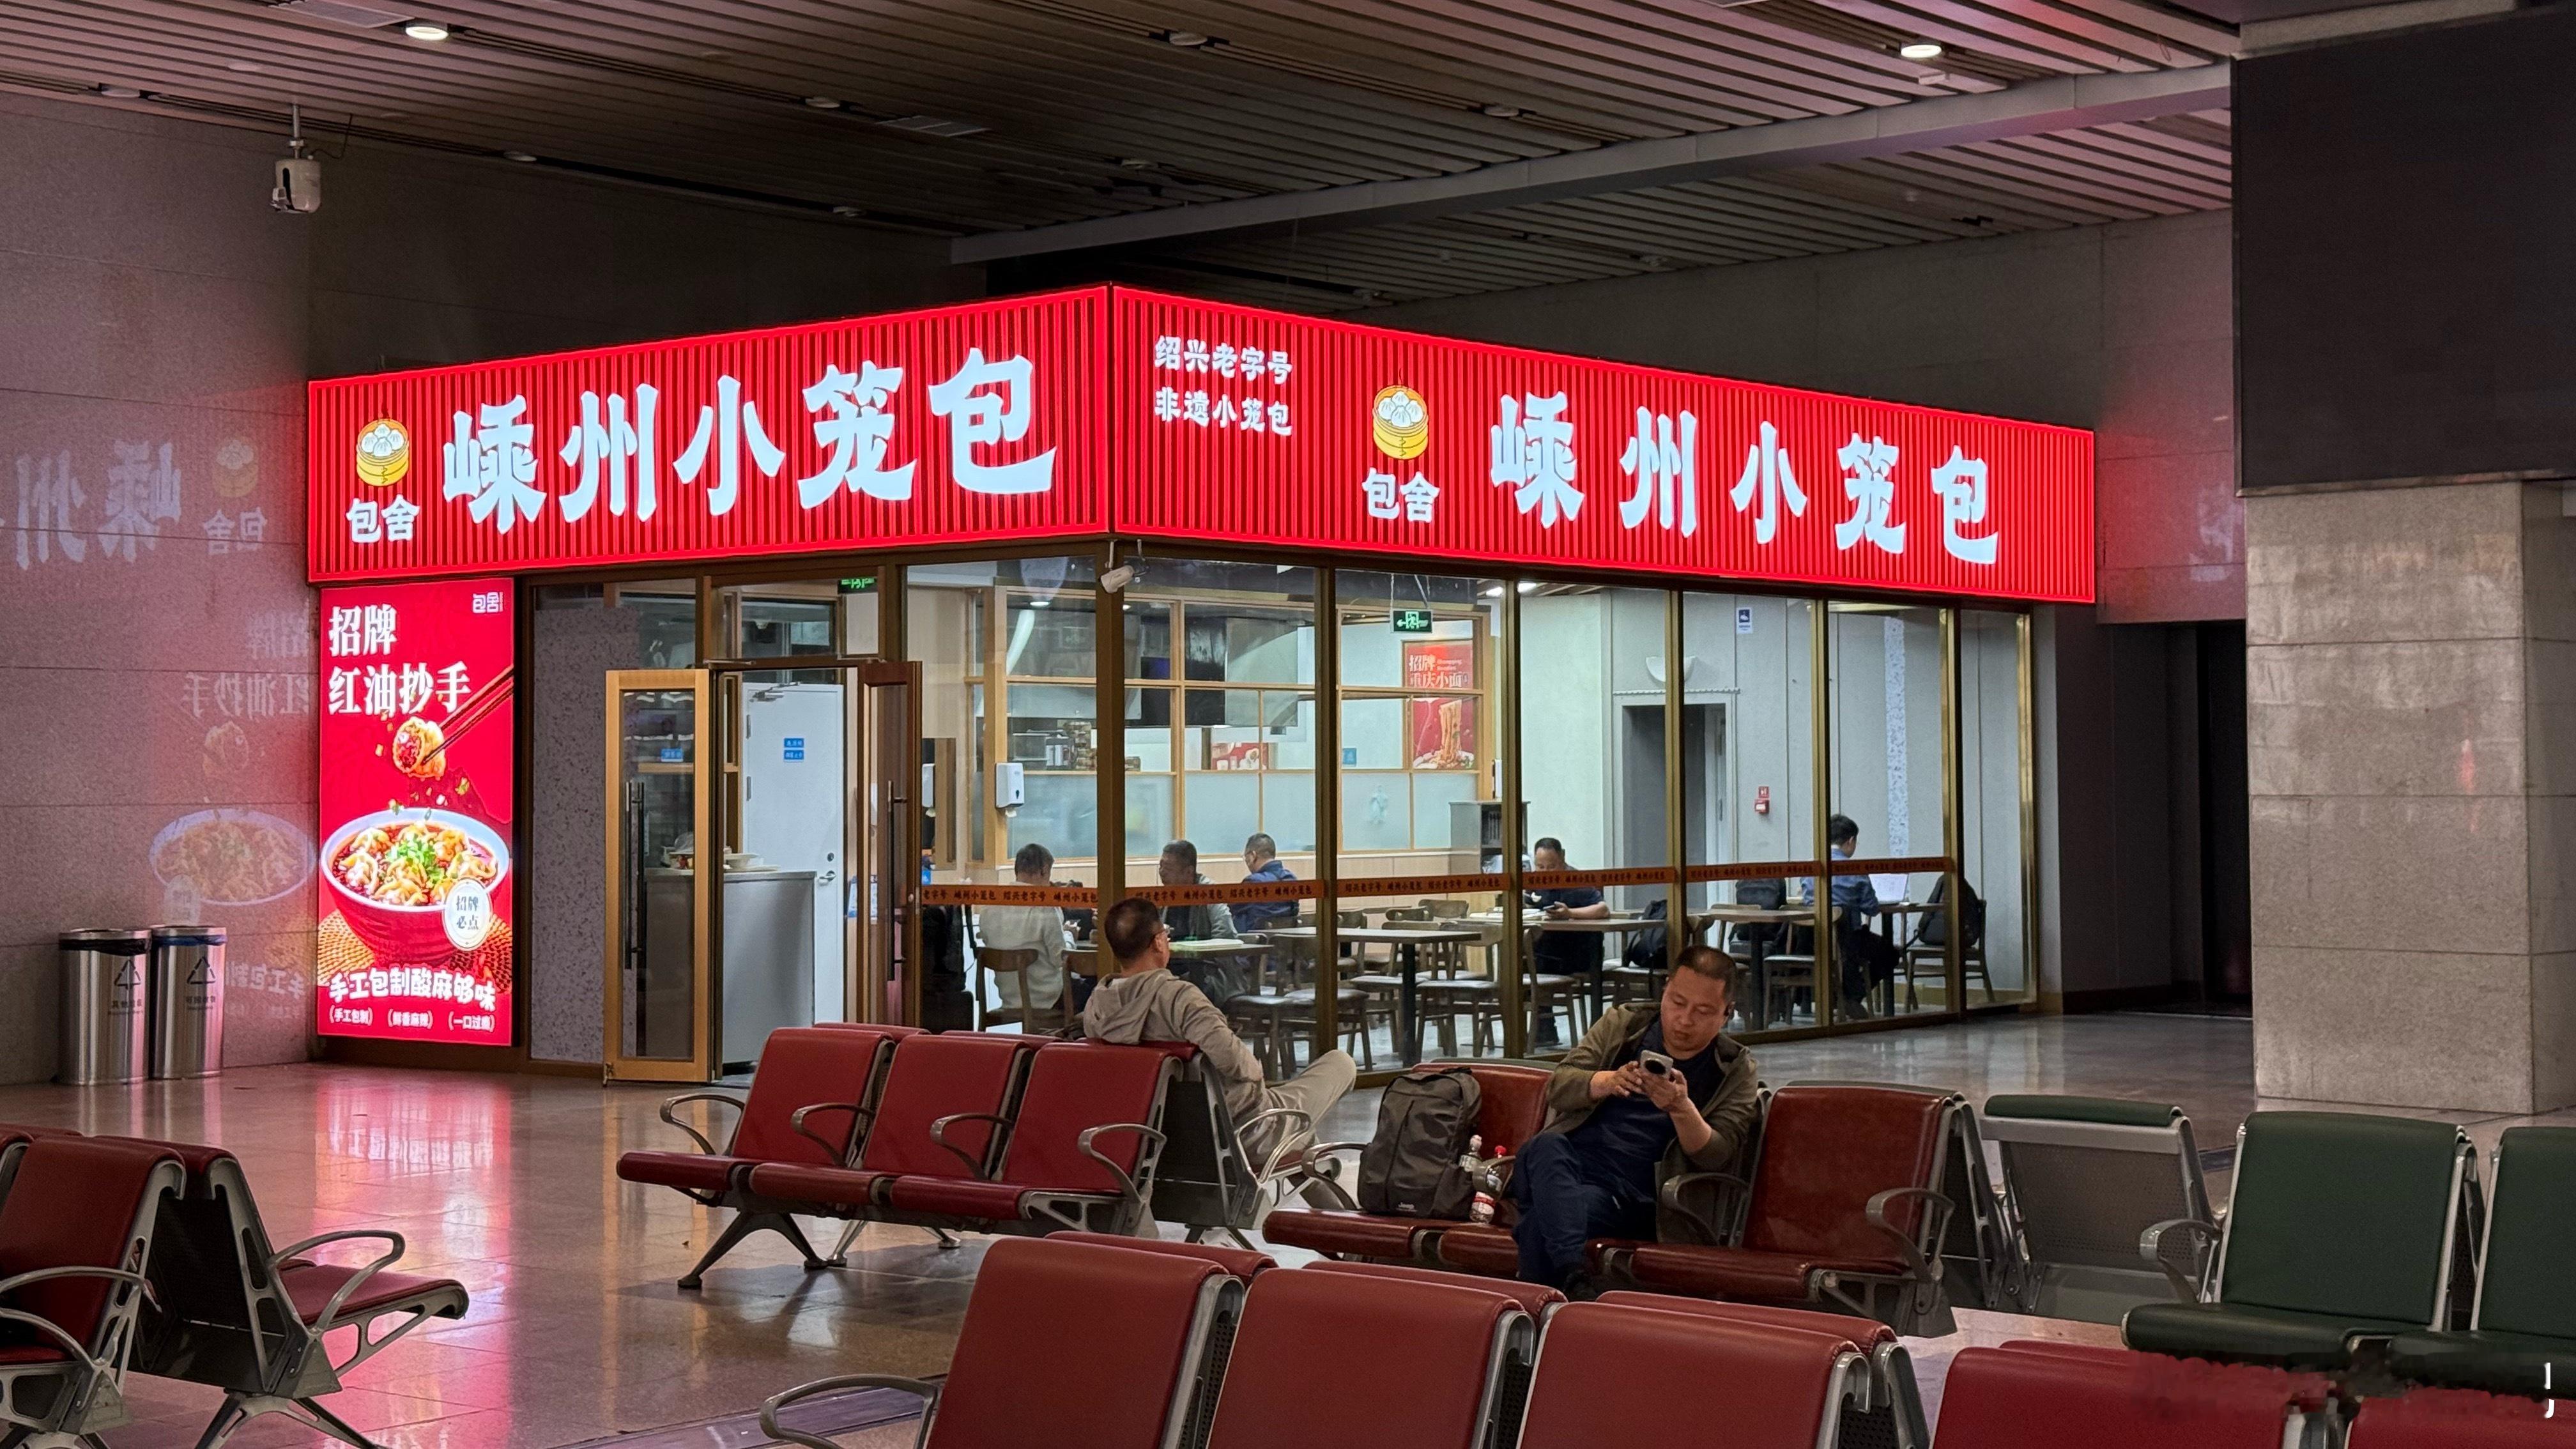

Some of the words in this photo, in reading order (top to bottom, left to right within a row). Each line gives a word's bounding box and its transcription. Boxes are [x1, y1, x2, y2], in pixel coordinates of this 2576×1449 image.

[1154, 335, 1292, 385] 绍兴老字号
[1154, 386, 1292, 436] 非遗小笼包
[442, 347, 1057, 535] 嵊州小笼包
[1361, 467, 1441, 523] 包舍
[1490, 390, 1999, 565] 嵊州小笼包
[346, 493, 420, 543] 包舍
[328, 604, 397, 657] 招牌
[1409, 654, 1436, 671] 招牌
[328, 661, 471, 717] 红油抄手
[456, 895, 479, 911] 招牌
[456, 914, 479, 930] 必点
[329, 967, 496, 1012] 手工包制酸麻够味
